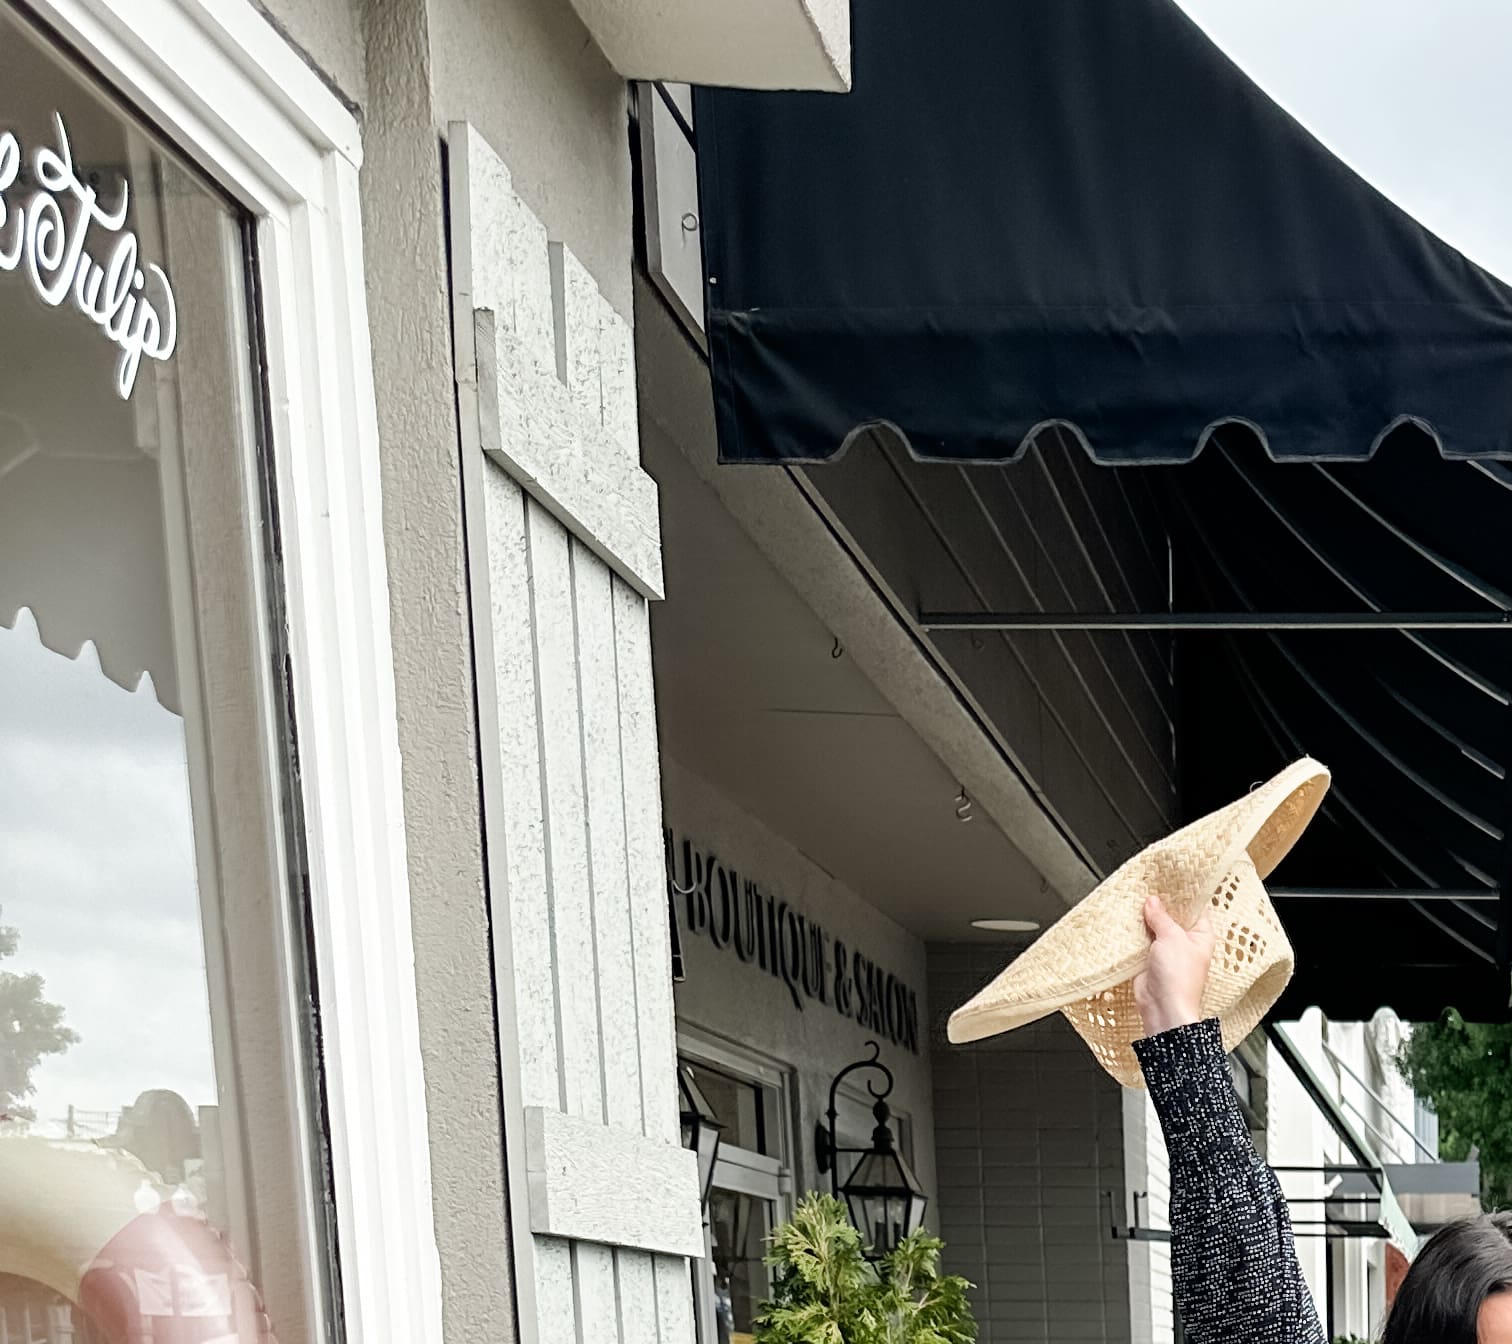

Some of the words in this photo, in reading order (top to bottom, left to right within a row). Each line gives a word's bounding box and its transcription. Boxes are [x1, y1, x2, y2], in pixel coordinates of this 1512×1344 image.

[28, 111, 177, 401] Tulip
[683, 840, 831, 1012] BOUTIQUE
[834, 940, 853, 1018] &
[854, 951, 918, 1056] SALON
